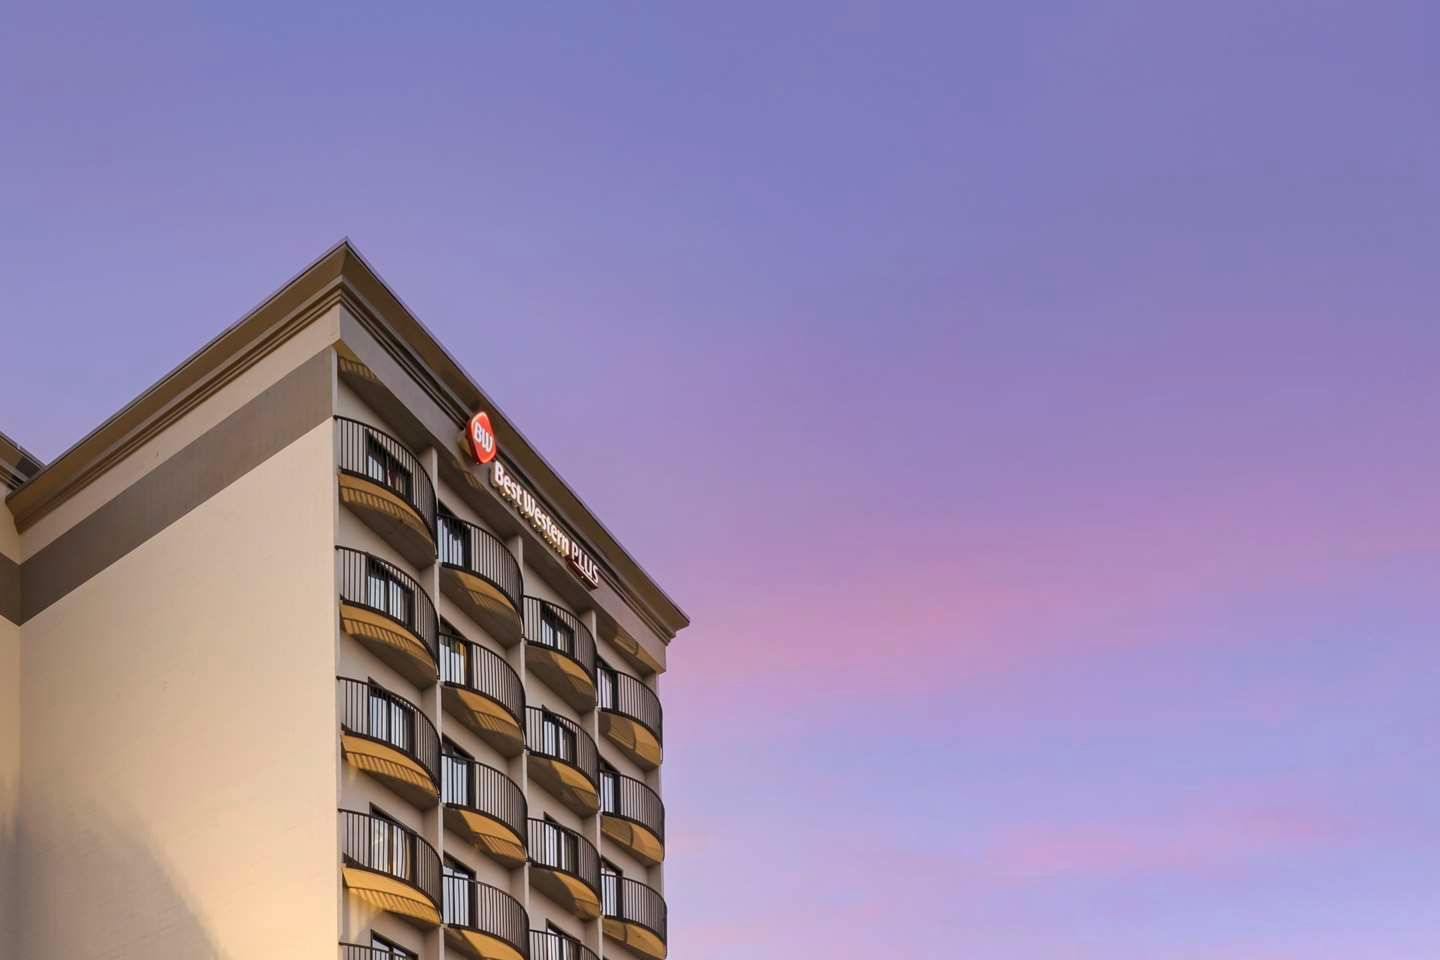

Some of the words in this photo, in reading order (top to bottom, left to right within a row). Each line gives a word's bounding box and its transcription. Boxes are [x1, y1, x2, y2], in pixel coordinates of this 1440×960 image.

[473, 421, 494, 452] BW
[494, 461, 523, 505] Best
[524, 490, 570, 555] Western
[571, 542, 600, 584] PLUS
